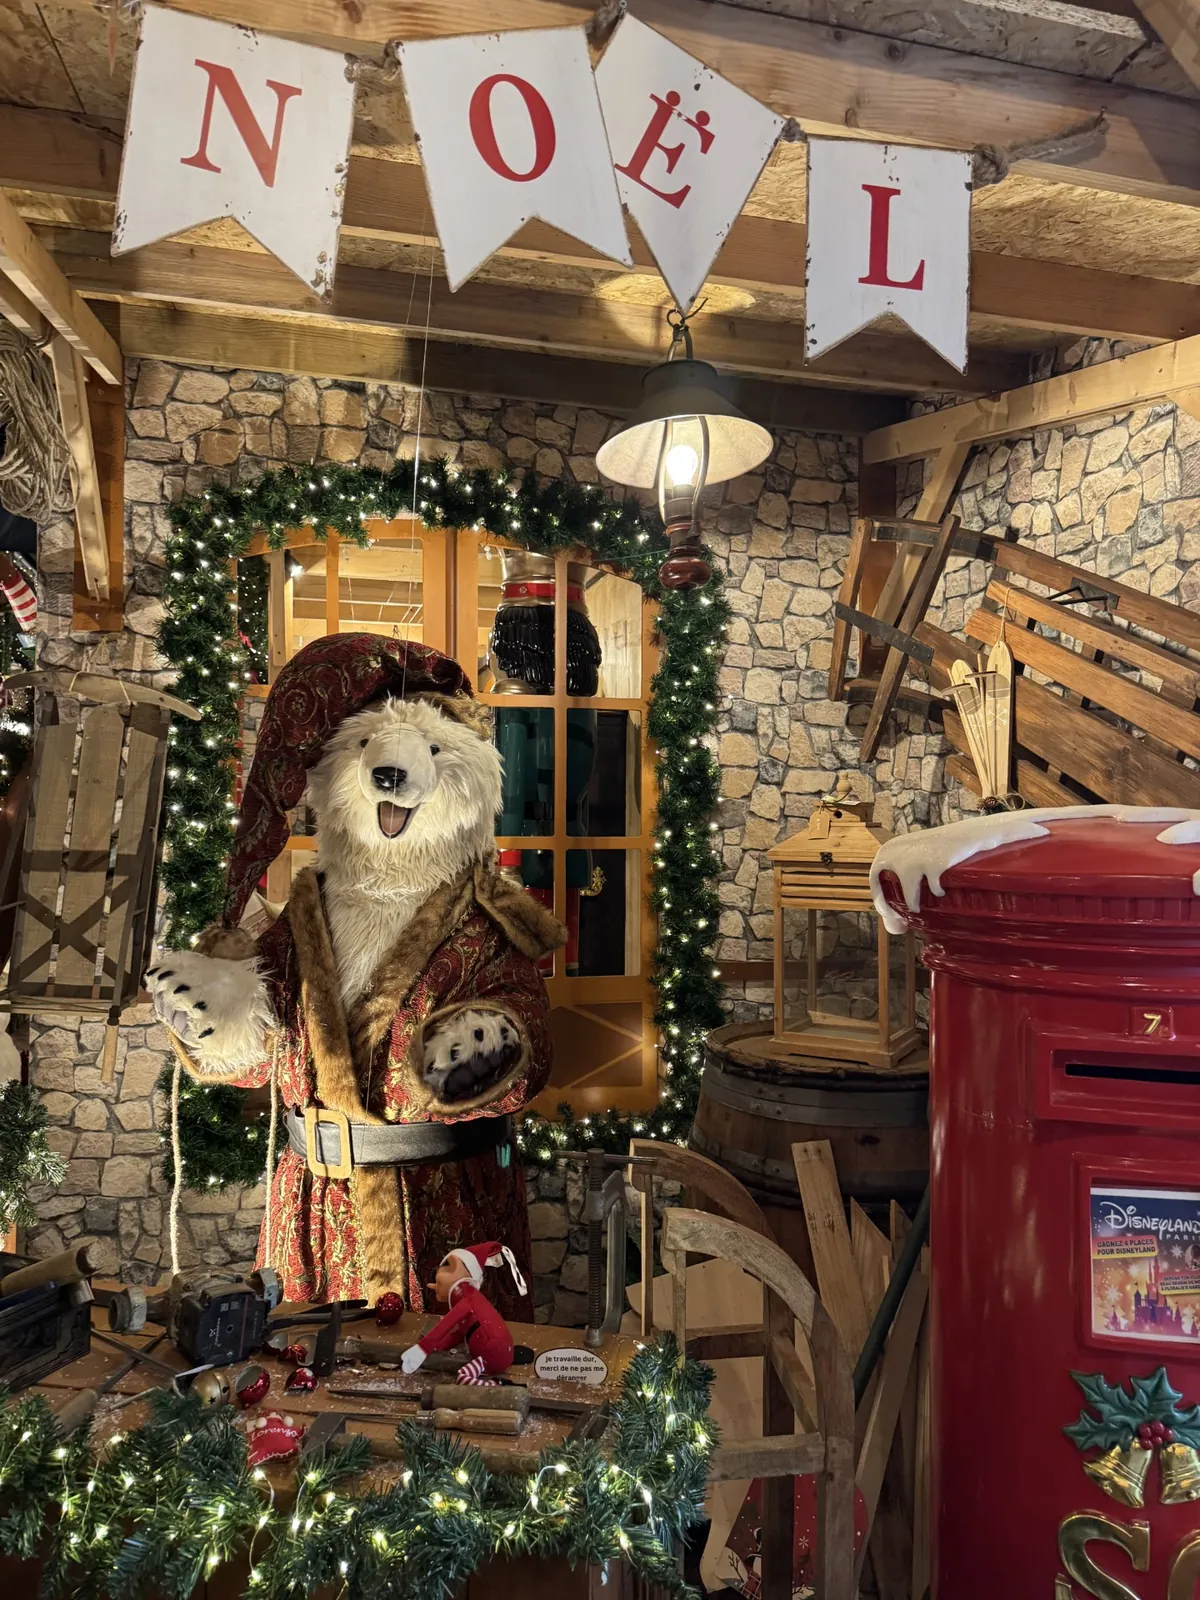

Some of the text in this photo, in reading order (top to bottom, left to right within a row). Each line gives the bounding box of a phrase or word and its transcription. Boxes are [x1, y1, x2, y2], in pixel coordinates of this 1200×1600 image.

[1143, 1013, 1161, 1035] 7
[1097, 1240, 1123, 1248] GAGNEZ
[1116, 1246, 1156, 1254] DISNEYLAND
